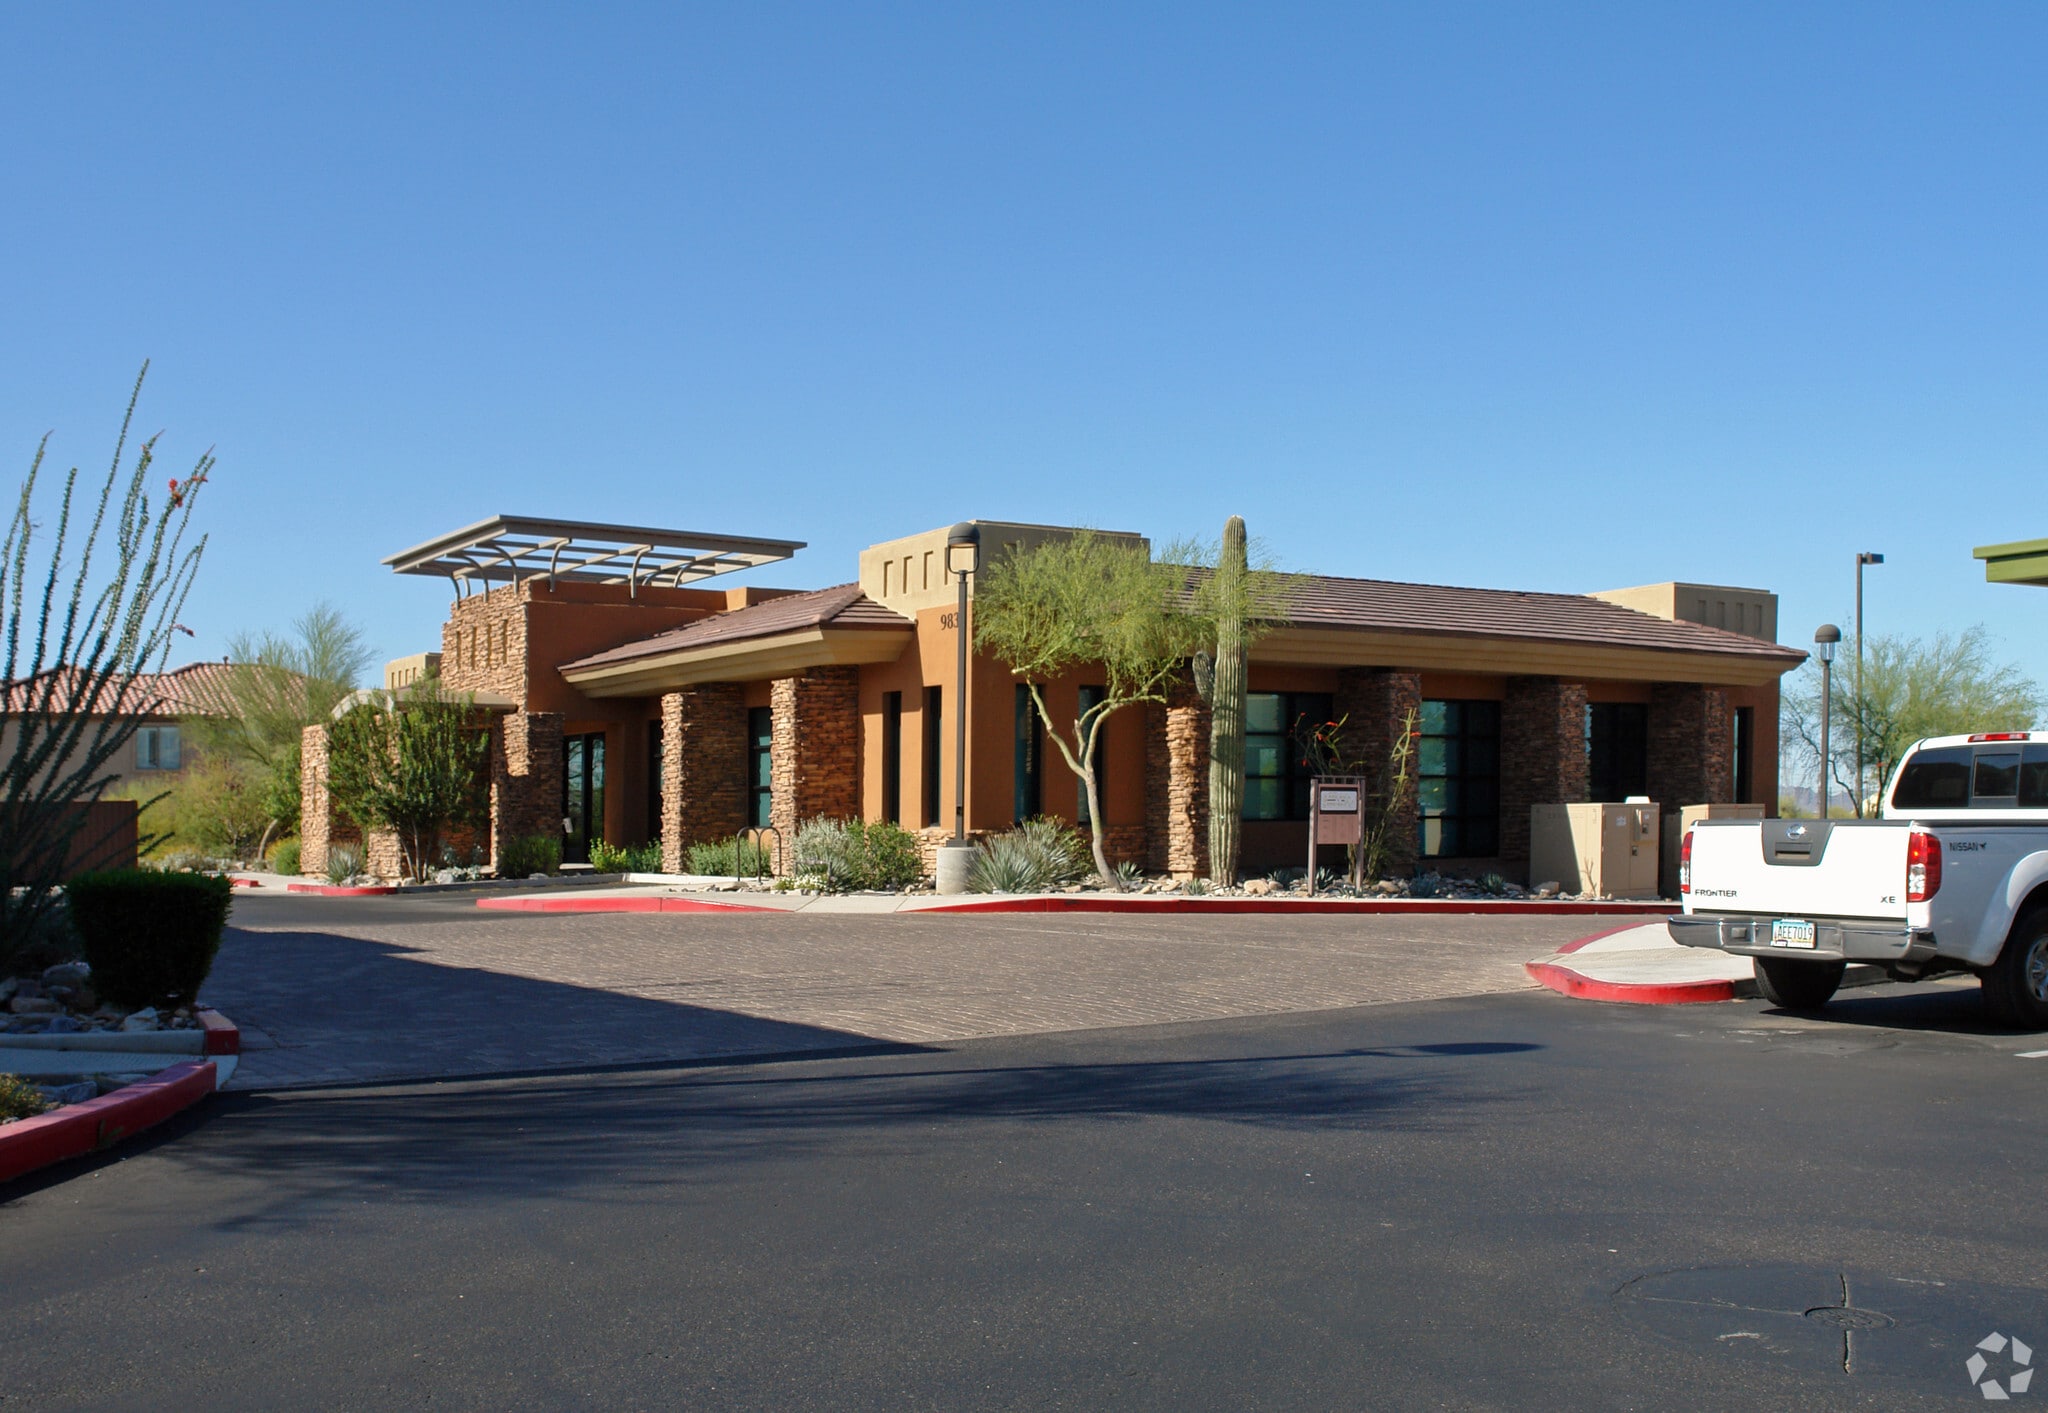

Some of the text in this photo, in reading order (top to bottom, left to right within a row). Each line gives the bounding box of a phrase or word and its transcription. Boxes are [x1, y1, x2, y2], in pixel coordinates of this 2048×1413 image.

[1949, 842, 1978, 851] NISSAN
[1695, 889, 1737, 897] FRONTIER
[1880, 896, 1896, 904] XE
[1778, 926, 1813, 940] AEE7019
